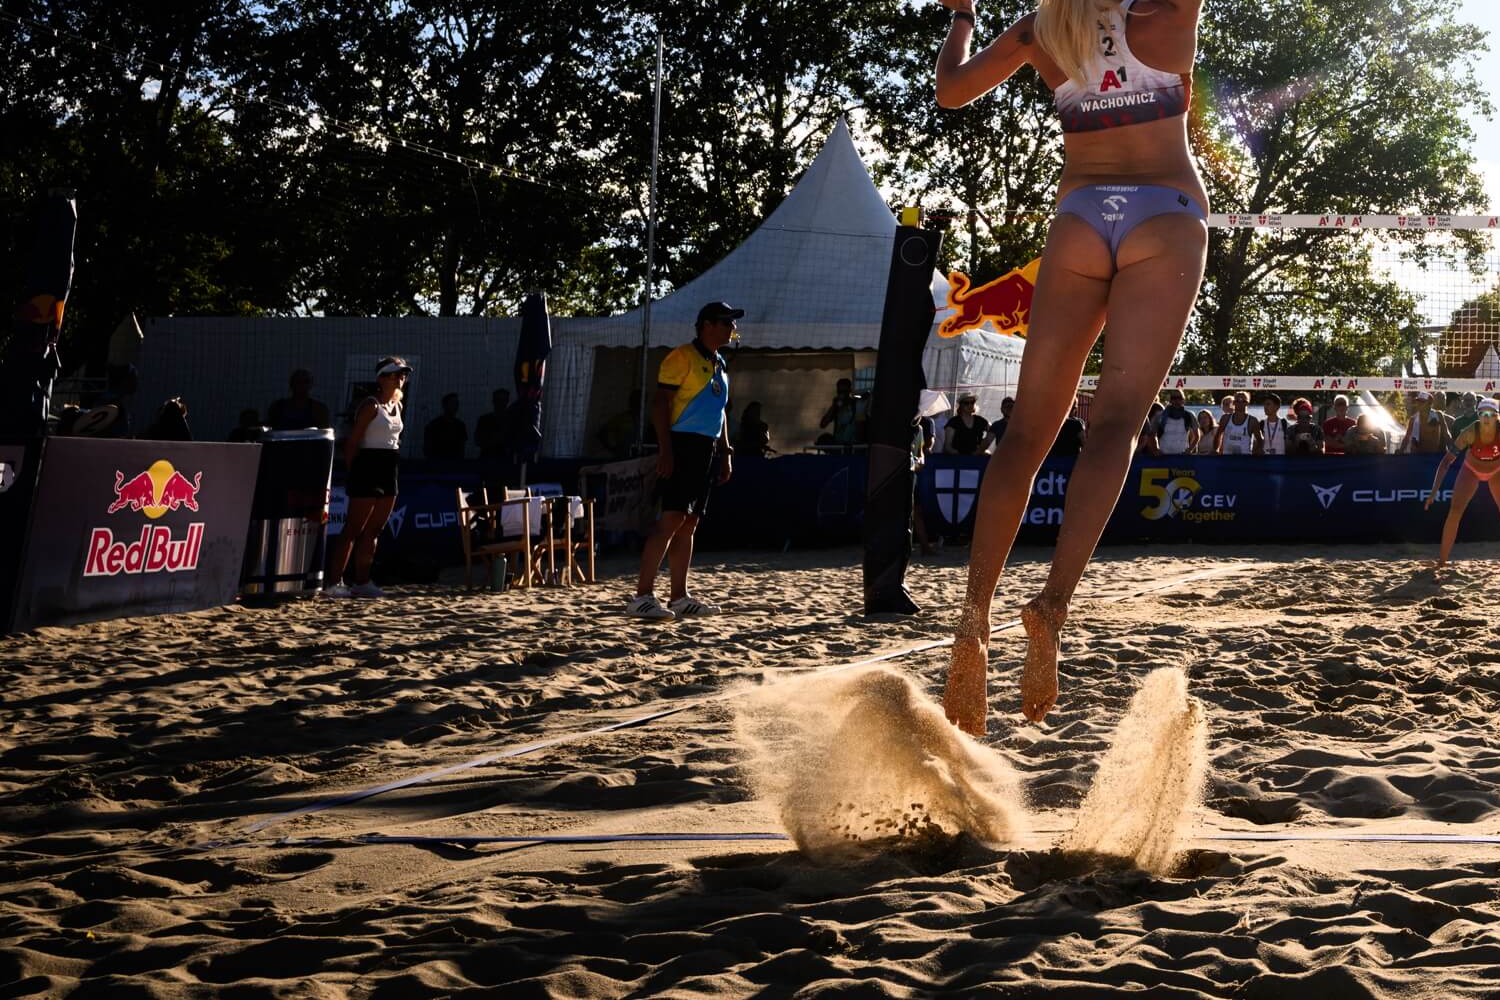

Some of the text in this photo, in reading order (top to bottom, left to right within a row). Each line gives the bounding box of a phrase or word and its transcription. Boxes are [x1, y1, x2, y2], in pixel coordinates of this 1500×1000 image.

[1101, 36, 1117, 55] 2
[1099, 66, 1128, 91] A1
[1080, 92, 1157, 113] WACHOWICZ
[1319, 216, 1362, 226] A1 A1 A1
[1488, 217, 1498, 227] A1
[1176, 377, 1186, 388] A1
[1313, 379, 1358, 389] A1 A1 A1
[1485, 382, 1495, 392] A1
[1201, 495, 1237, 508] CEV
[415, 511, 457, 529] CUP
[1181, 510, 1236, 524] Together
[84, 522, 205, 576] Red Bull
